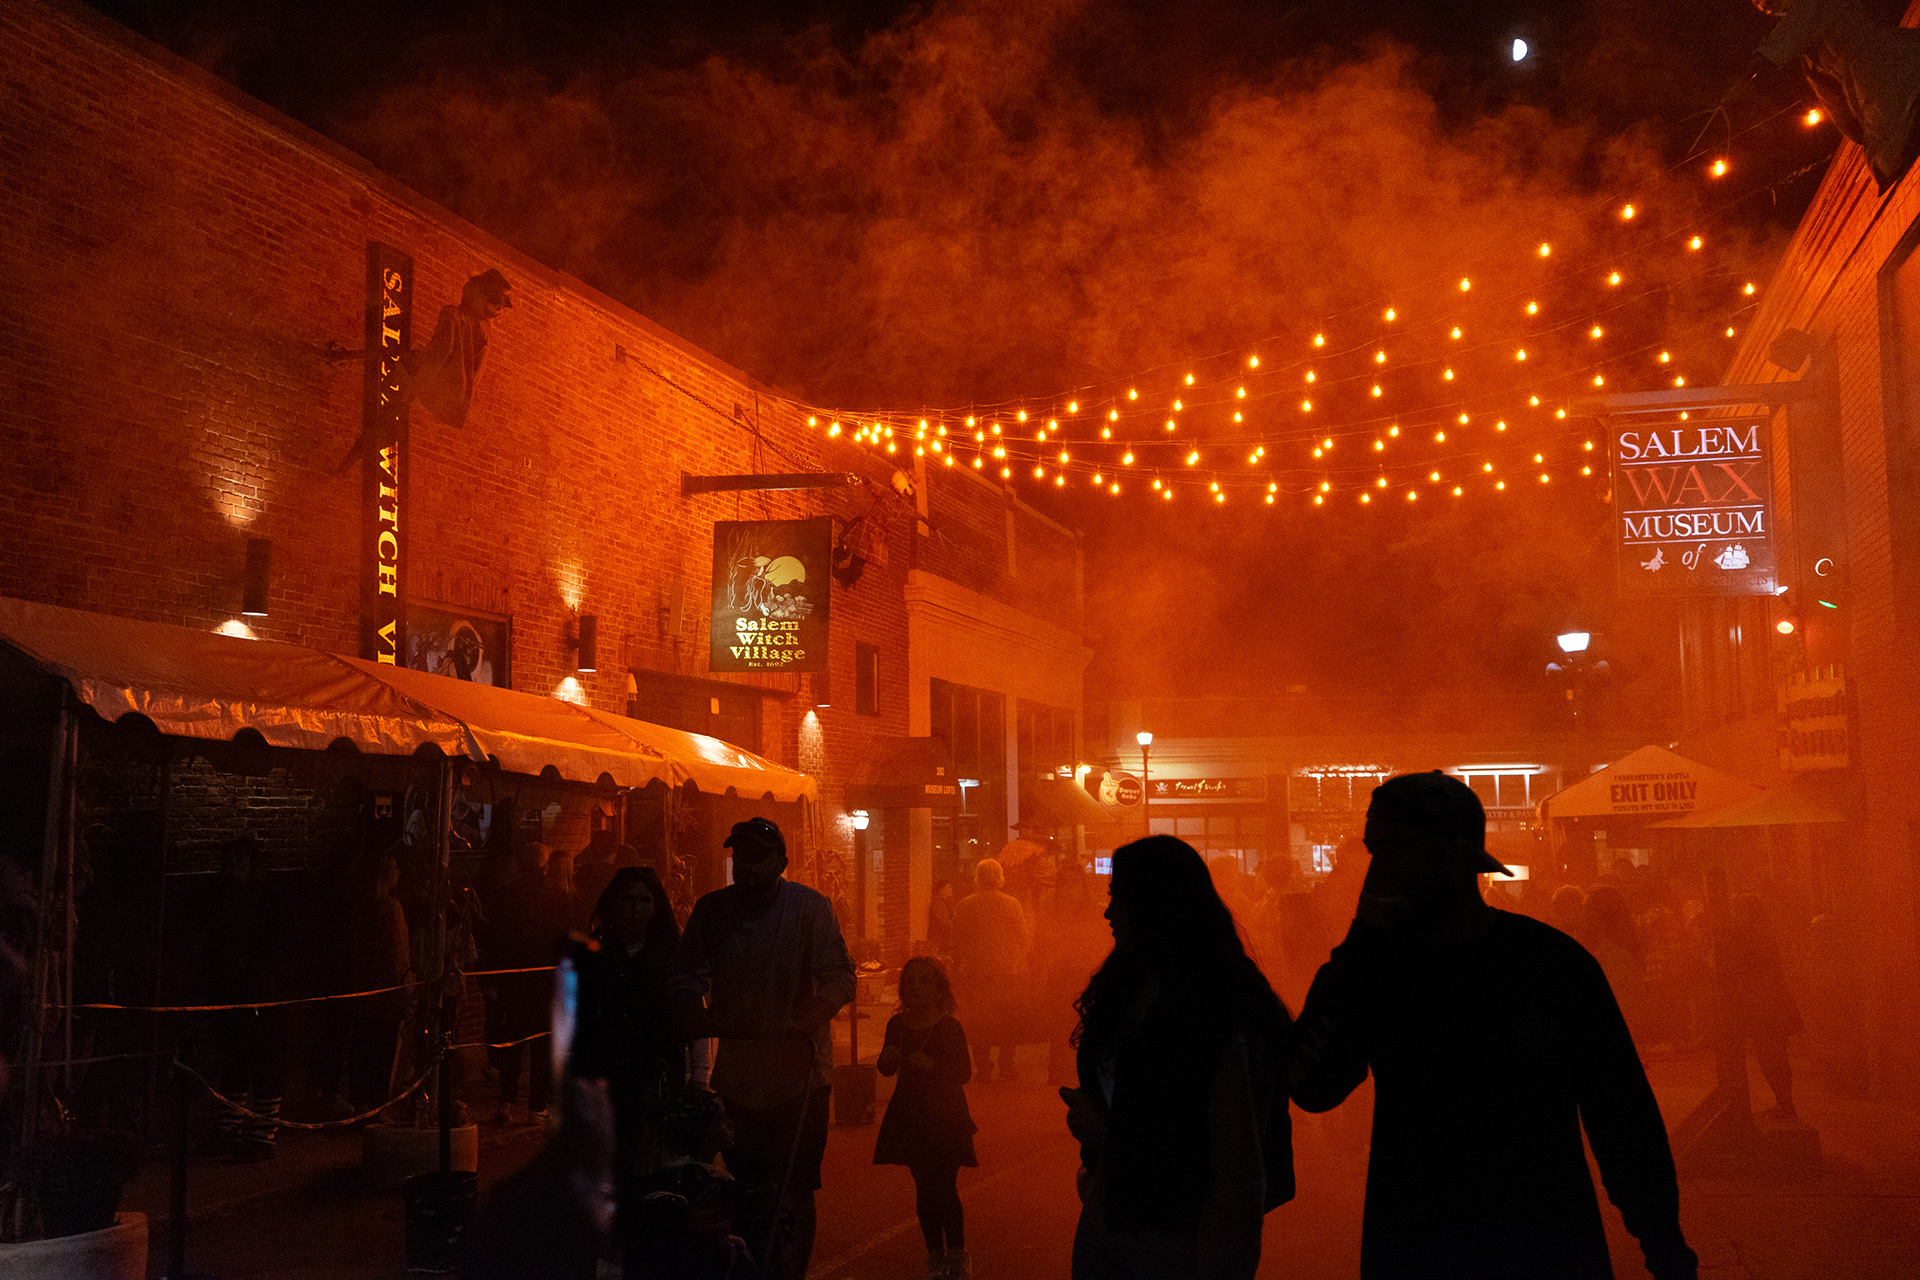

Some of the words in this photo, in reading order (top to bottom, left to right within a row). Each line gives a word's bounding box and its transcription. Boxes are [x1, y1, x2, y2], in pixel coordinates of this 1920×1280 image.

[1619, 425, 1762, 460] SALEM
[1621, 461, 1763, 506] WAX
[378, 441, 399, 598] WITCH
[1623, 511, 1766, 539] MUSEUM
[1681, 543, 1707, 571] of
[736, 617, 800, 632] Salem
[736, 632, 799, 646] Witch
[729, 646, 806, 663] Village
[1610, 783, 1649, 803] EXIT
[1653, 781, 1697, 801] ONLY
